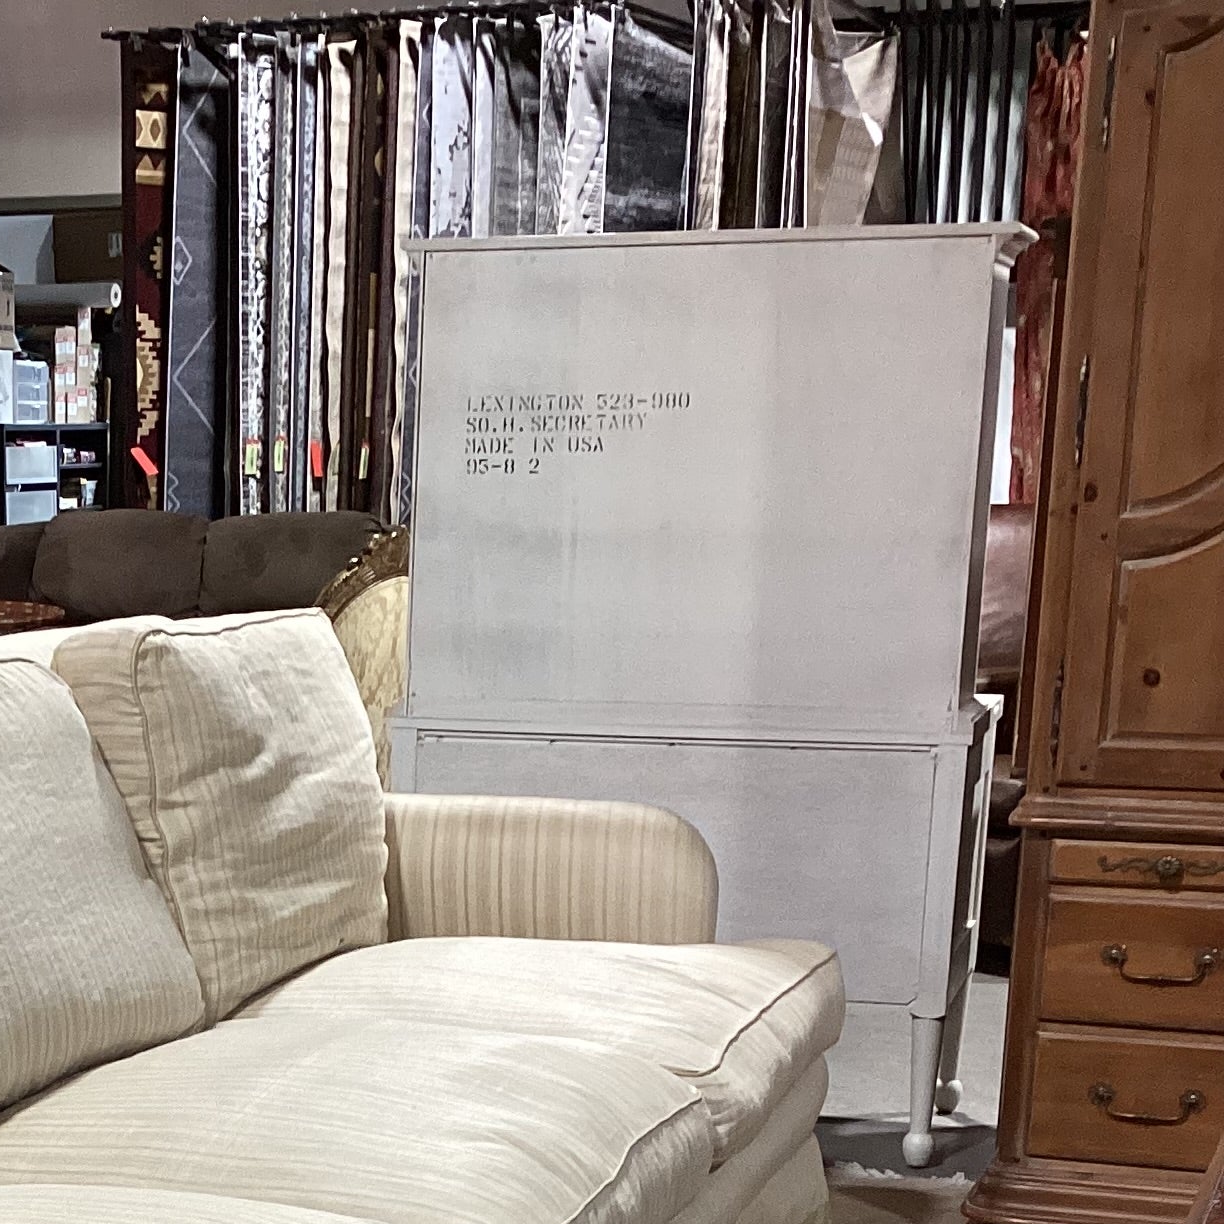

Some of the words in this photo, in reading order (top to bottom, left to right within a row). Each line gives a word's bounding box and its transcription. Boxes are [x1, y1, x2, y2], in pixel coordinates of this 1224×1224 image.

[467, 394, 584, 412] LEXINGTON
[465, 436, 514, 454] MADE
[533, 436, 554, 453] IN
[567, 435, 604, 453] USA
[528, 457, 540, 474] 2
